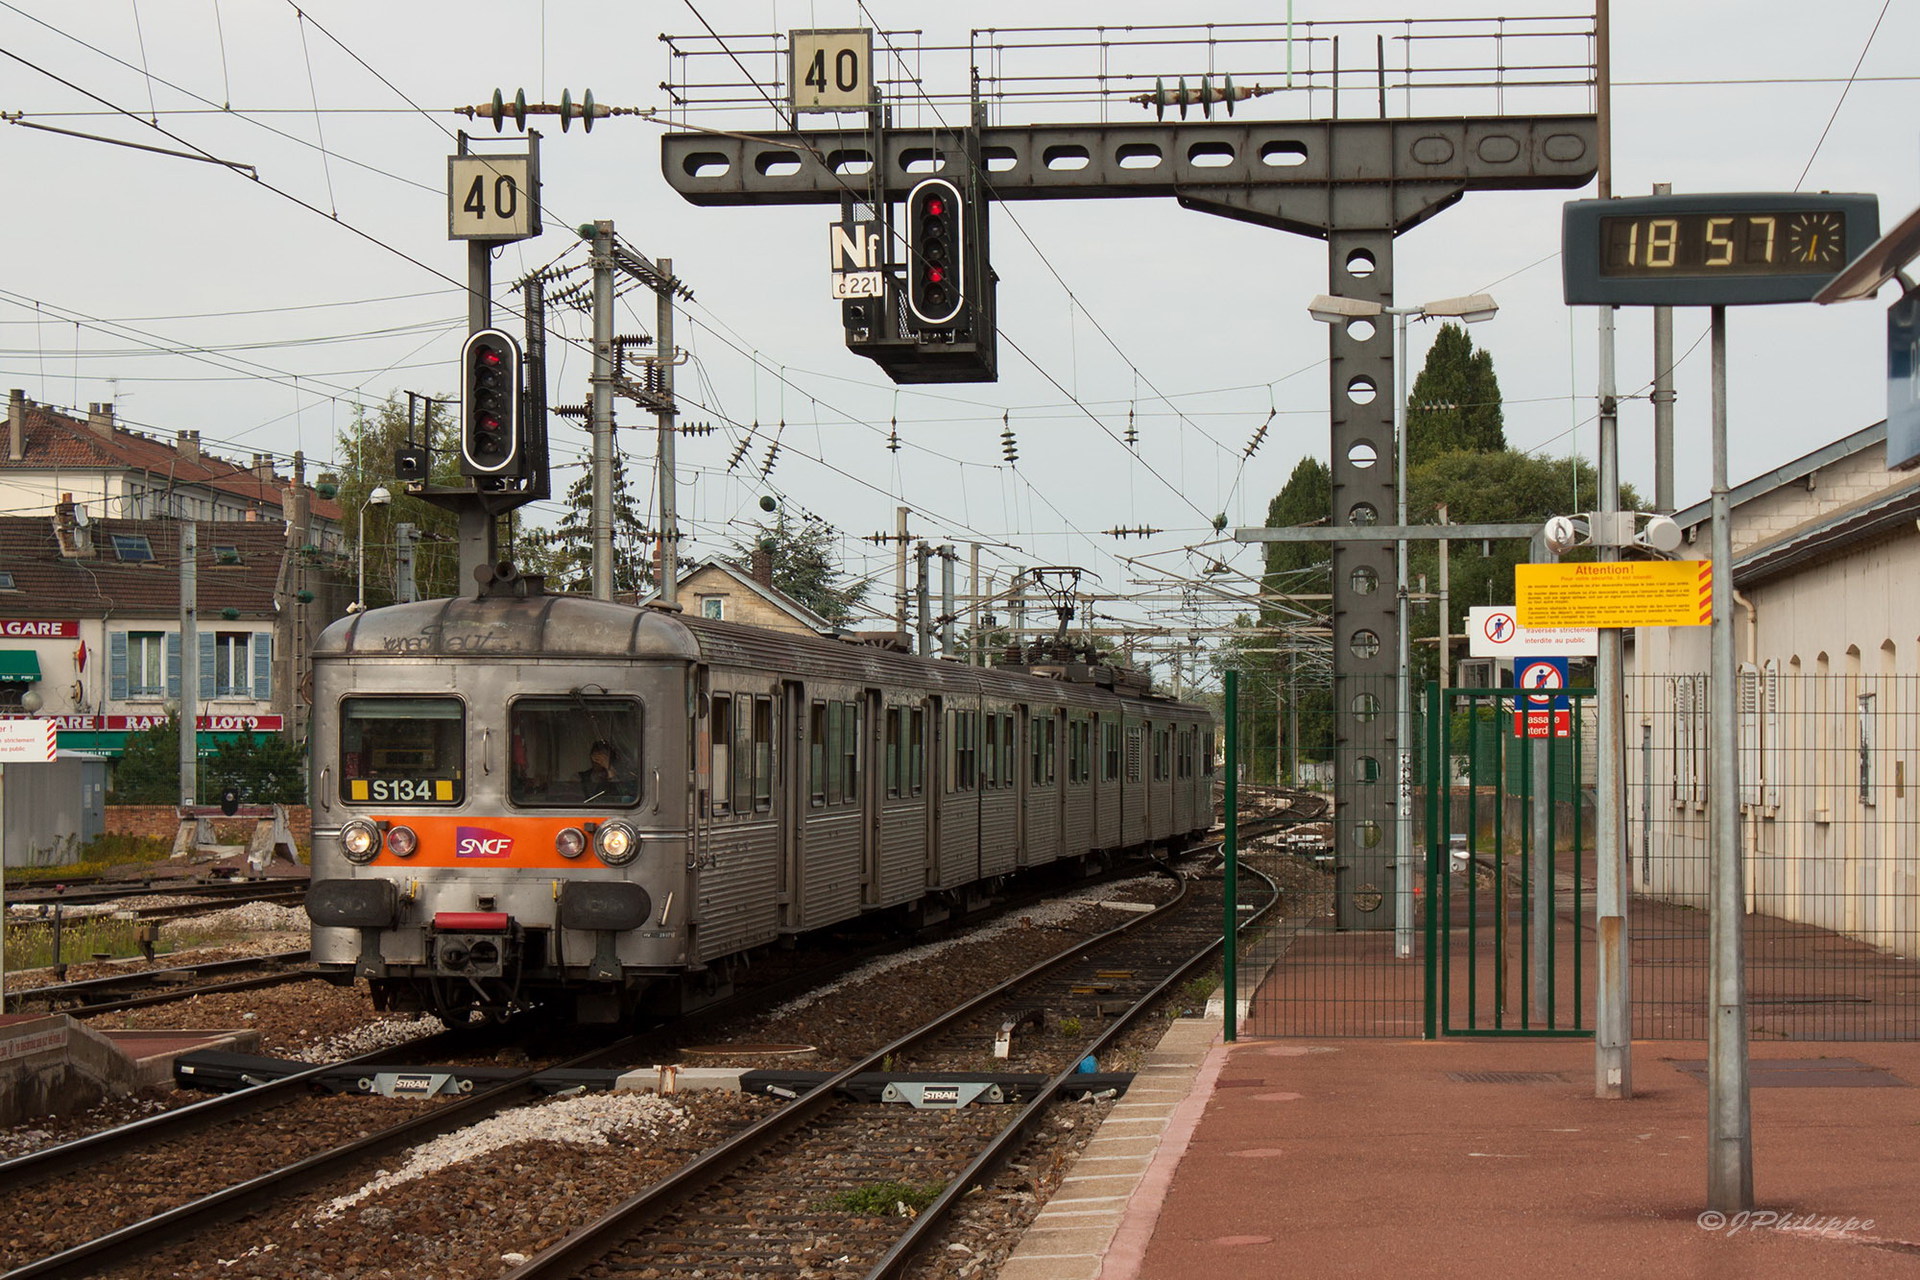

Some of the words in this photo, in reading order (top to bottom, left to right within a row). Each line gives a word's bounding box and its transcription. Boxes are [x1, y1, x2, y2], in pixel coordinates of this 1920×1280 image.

[804, 48, 858, 93] 40
[463, 174, 517, 219] 40
[832, 225, 881, 269] Nf
[1628, 218, 1678, 268] 18
[1706, 216, 1775, 266] 57
[7, 622, 62, 635] GARE
[1566, 637, 1585, 645] public
[210, 716, 259, 729] LOTO
[372, 780, 431, 801] S134
[458, 838, 512, 855] SNCF
[395, 1080, 432, 1089] STRAIL
[923, 1091, 959, 1100] STRAIL
